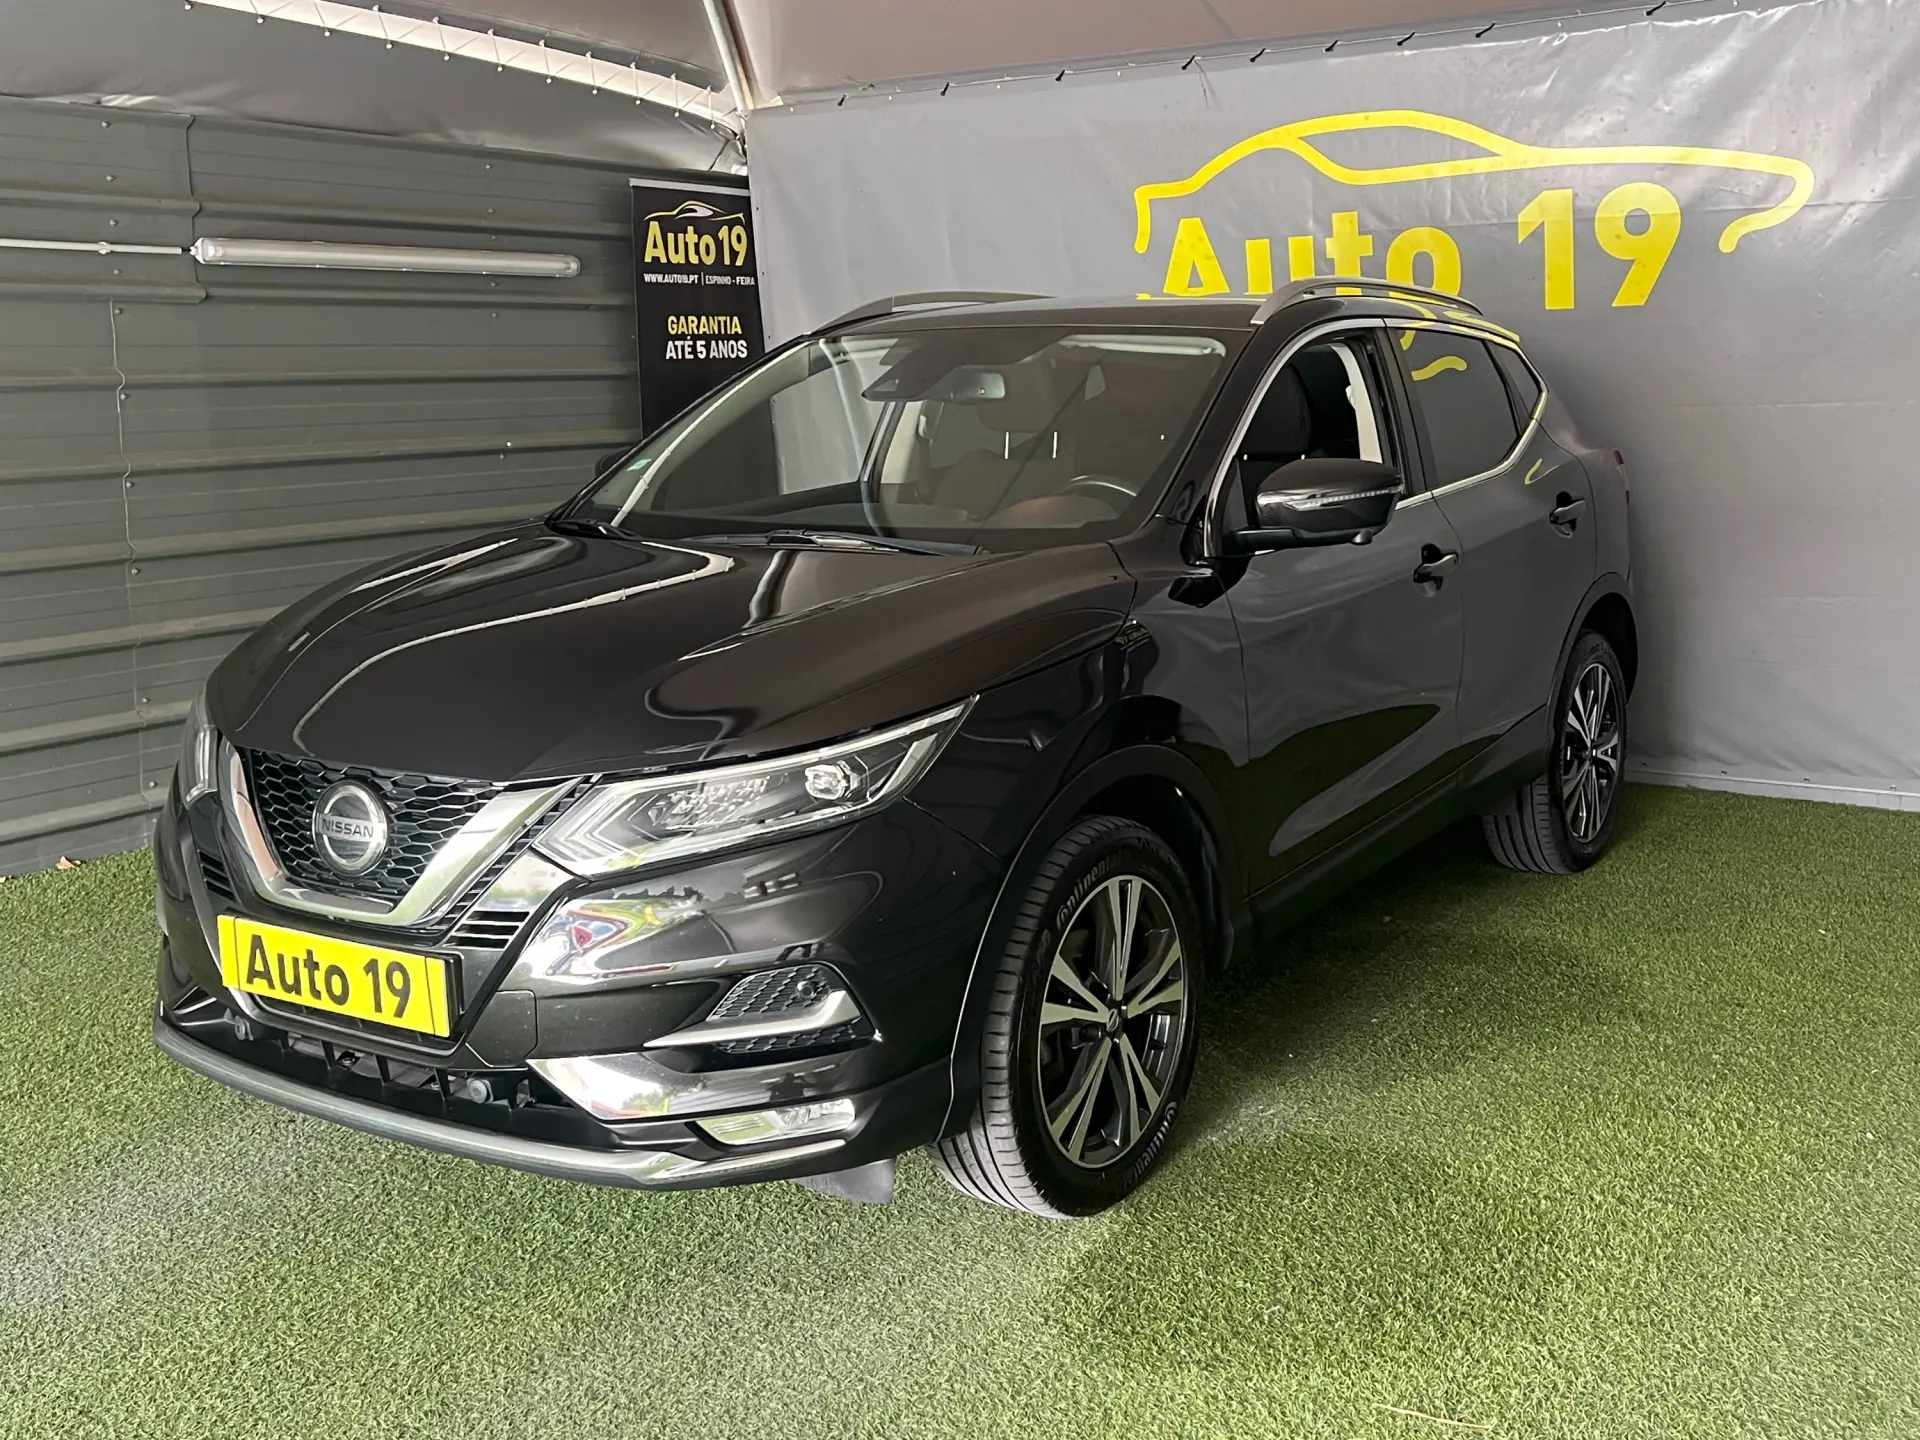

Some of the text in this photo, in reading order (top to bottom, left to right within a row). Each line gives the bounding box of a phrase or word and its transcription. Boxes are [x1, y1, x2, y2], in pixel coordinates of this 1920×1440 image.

[644, 220, 748, 266] Auto 19
[1163, 182, 1682, 310] Auto 19
[736, 277, 755, 287] FEIRA
[667, 315, 742, 335] GARANTIA
[665, 335, 748, 360] ATÉ 5 ANOS
[321, 817, 374, 839] NISSAN
[246, 933, 411, 1019] Auto 19
